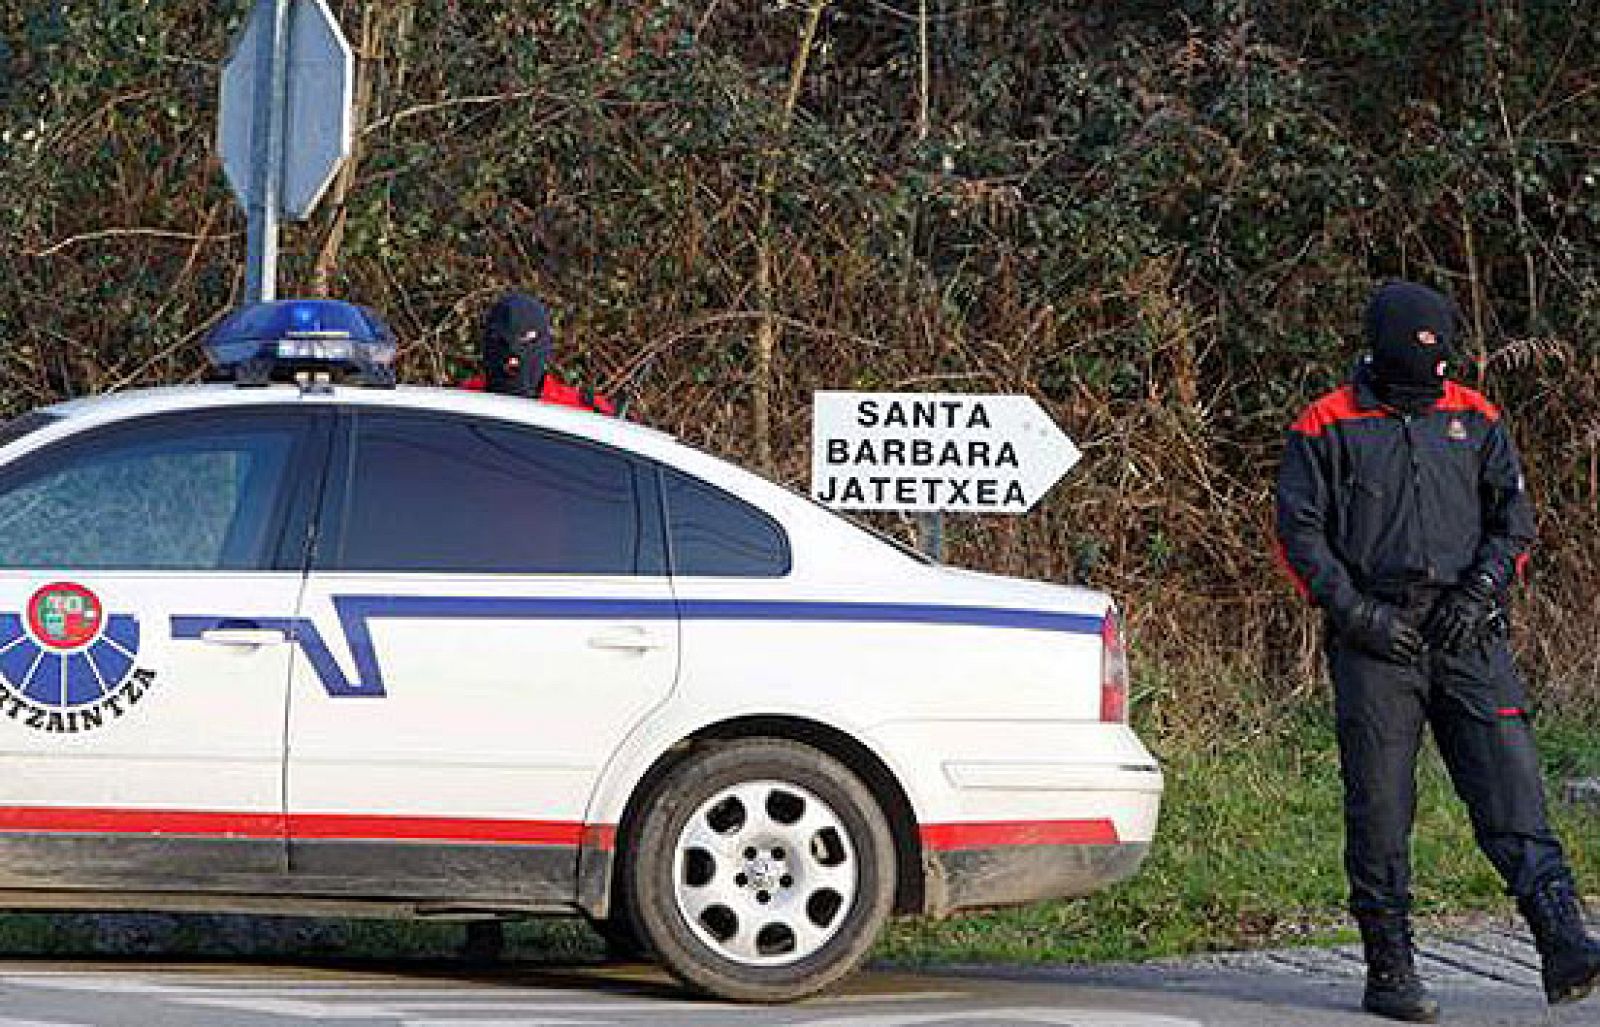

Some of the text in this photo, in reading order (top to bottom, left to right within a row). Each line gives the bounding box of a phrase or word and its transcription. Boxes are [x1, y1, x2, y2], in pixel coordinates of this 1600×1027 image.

[857, 400, 991, 428] SANTA
[826, 438, 1019, 467] BARBARA
[817, 476, 1027, 506] JATETXEA
